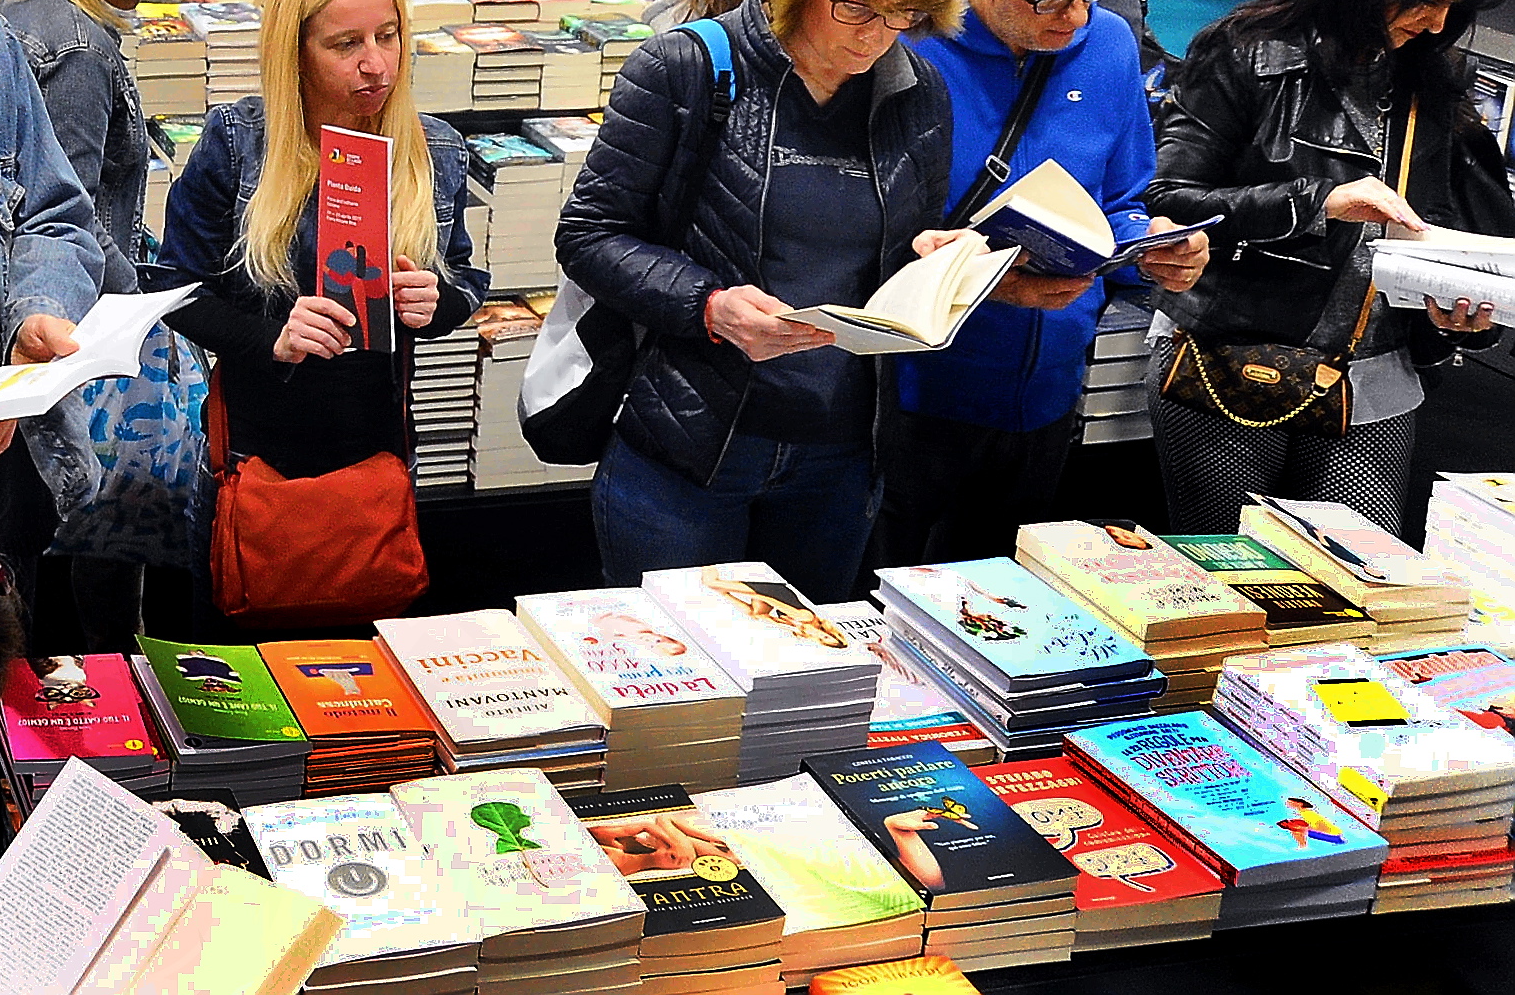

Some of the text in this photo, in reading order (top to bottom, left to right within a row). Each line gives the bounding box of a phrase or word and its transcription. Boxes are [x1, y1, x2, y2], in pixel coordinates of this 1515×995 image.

[416, 649, 543, 674] Vaccini
[445, 687, 569, 709] MANTOVANI
[611, 680, 680, 699] dieta
[830, 766, 894, 786] Poterti
[895, 759, 957, 779] parlare
[877, 775, 937, 793] ancora
[269, 829, 408, 867] DORMI
